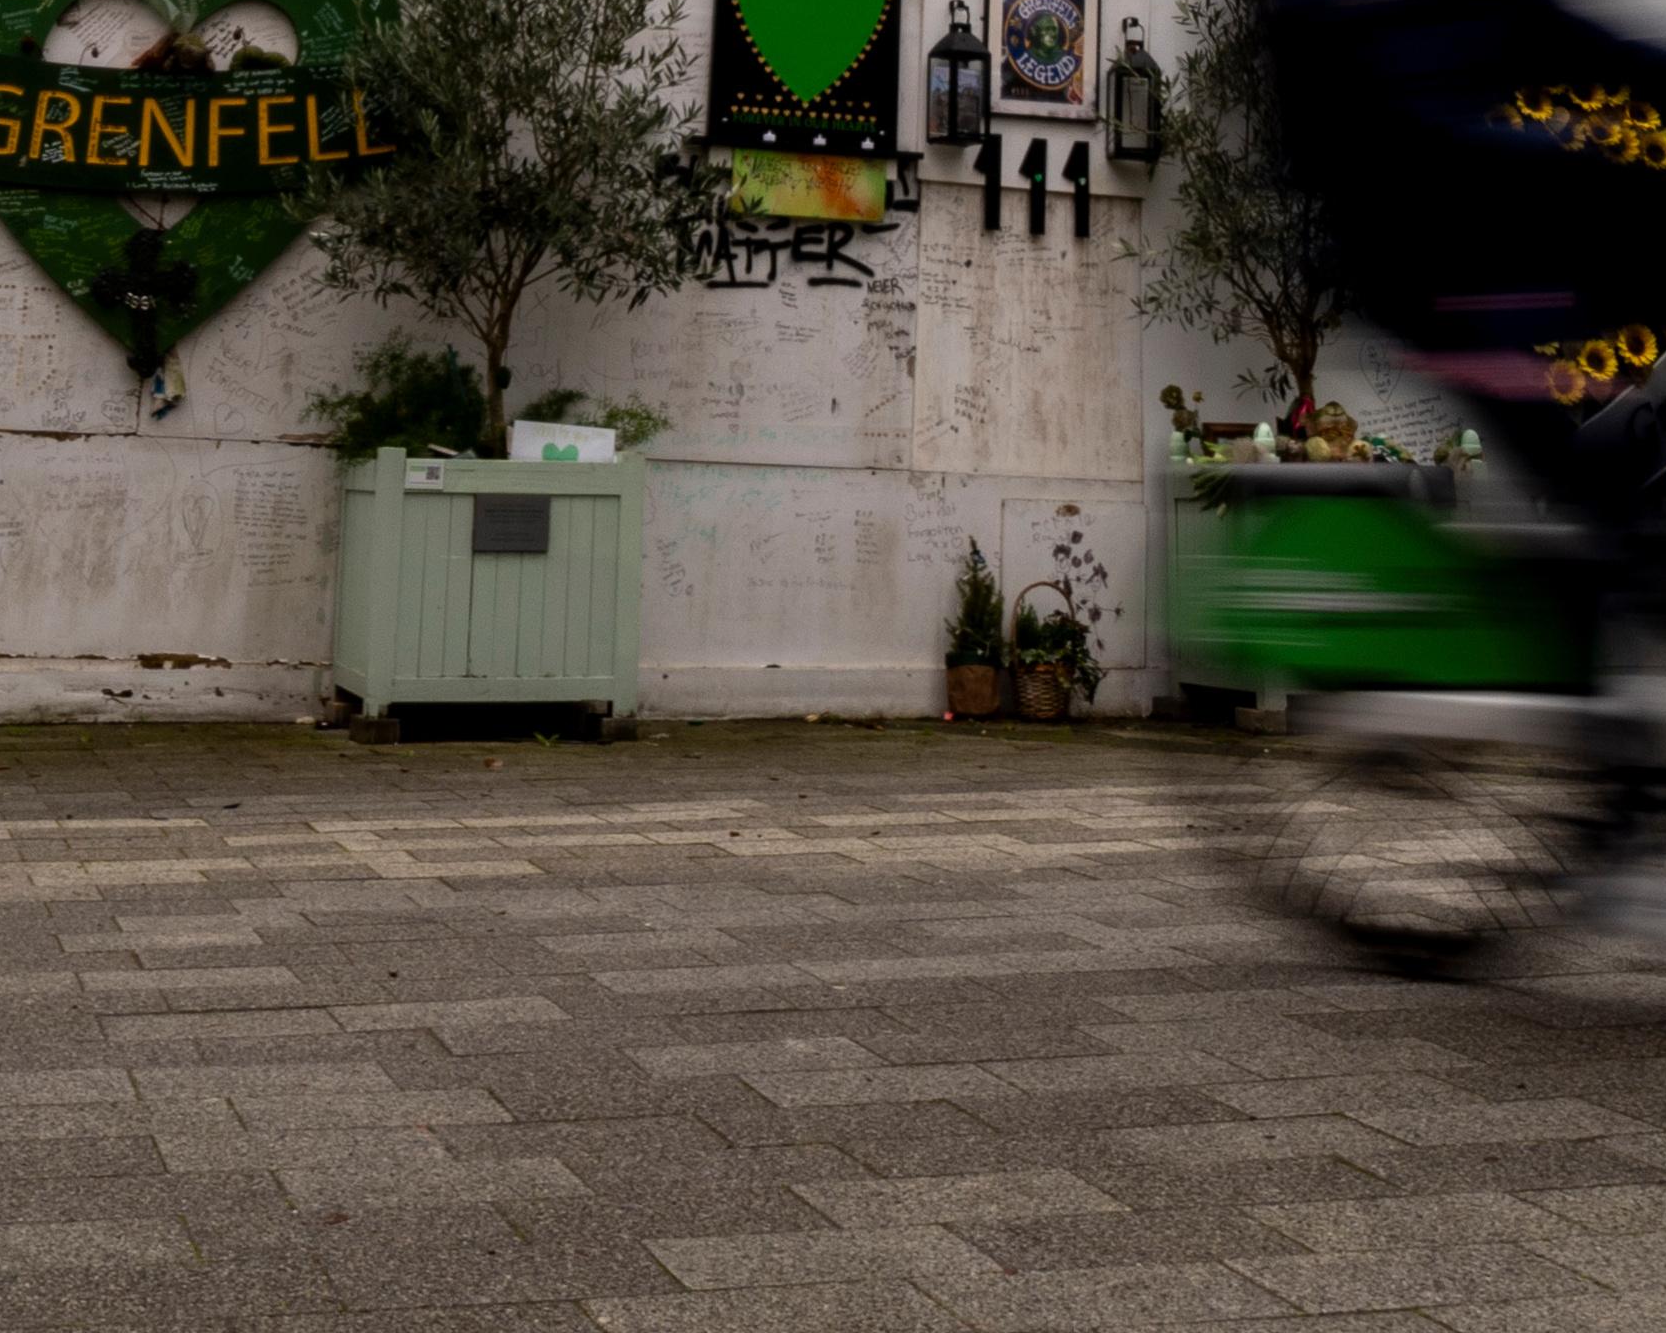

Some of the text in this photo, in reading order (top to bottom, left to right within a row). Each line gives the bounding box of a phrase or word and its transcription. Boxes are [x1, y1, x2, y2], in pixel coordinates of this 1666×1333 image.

[1016, 54, 1076, 85] LEGEND
[733, 113, 877, 133] FOREVER IN OUR HEARTS
